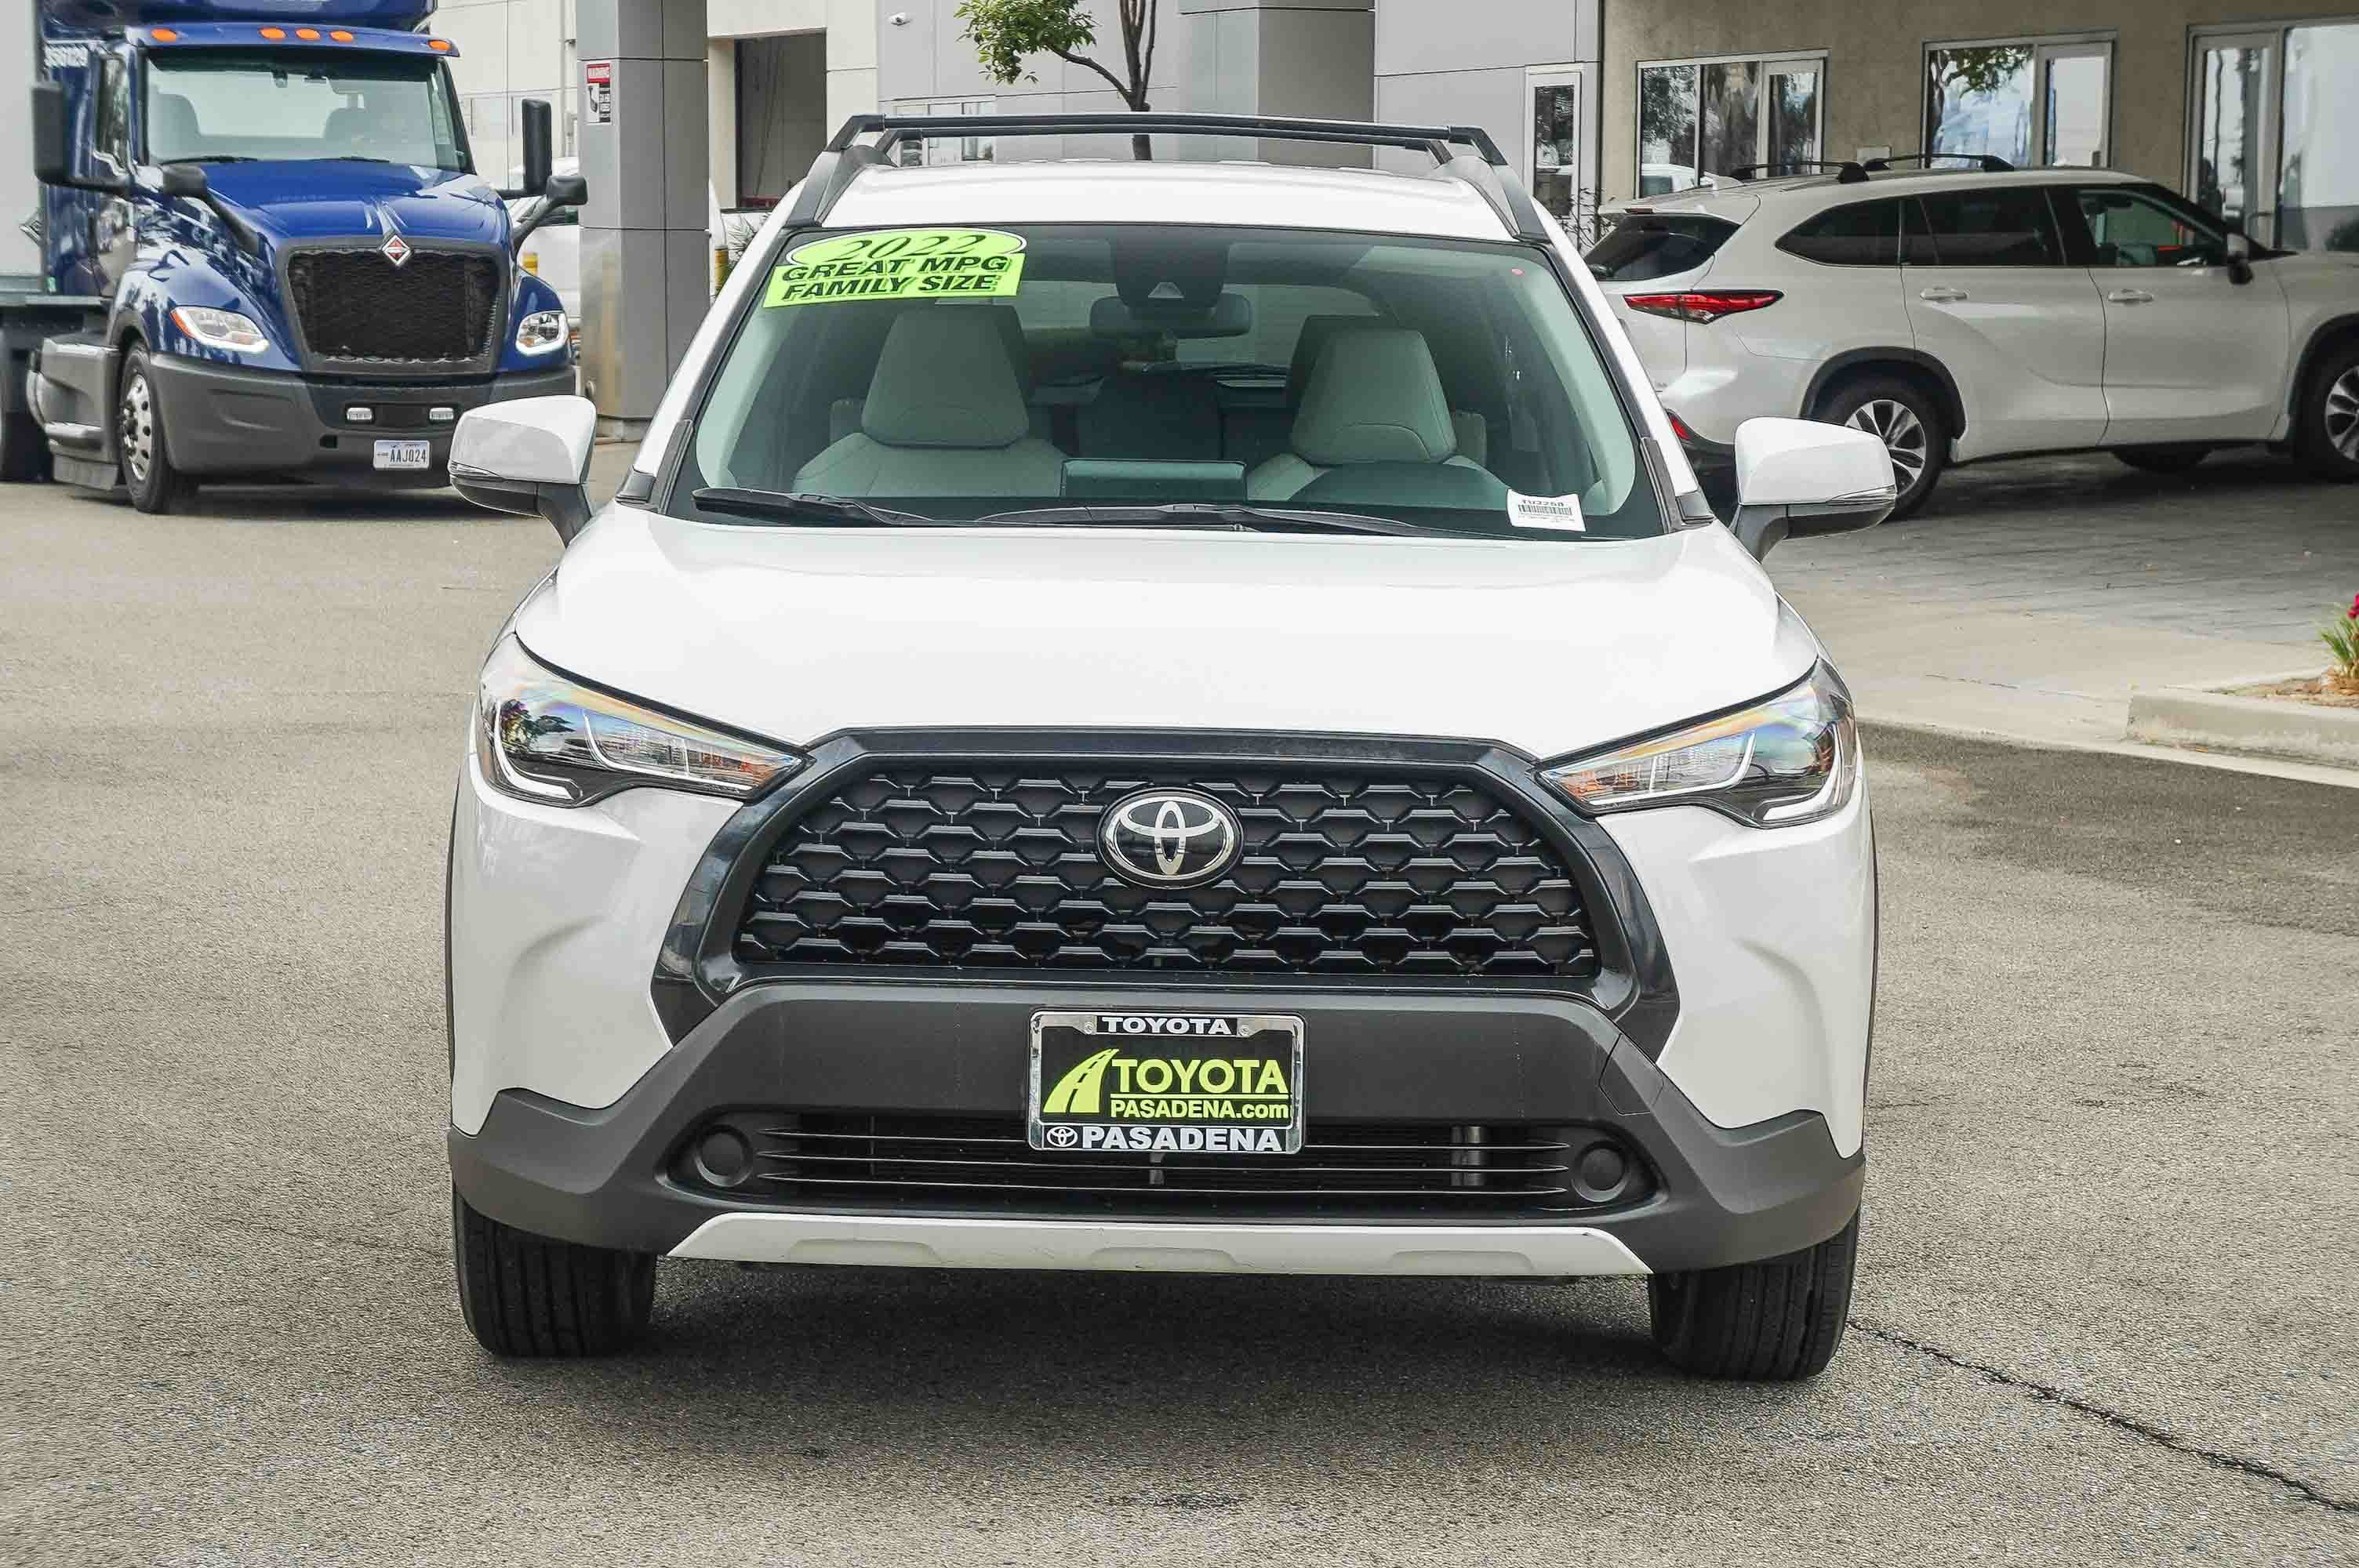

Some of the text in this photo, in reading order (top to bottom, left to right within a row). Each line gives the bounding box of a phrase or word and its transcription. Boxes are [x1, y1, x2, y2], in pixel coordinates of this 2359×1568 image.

[823, 234, 986, 263] 2022
[784, 256, 1010, 281] GREAT MPG
[781, 274, 998, 300] FAMILY SIZE
[1102, 1017, 1231, 1035] TOYOTA
[1111, 1058, 1289, 1094] TOYOTA
[1110, 1099, 1289, 1119] PASADENA.com
[1082, 1126, 1282, 1152] PASADENA
